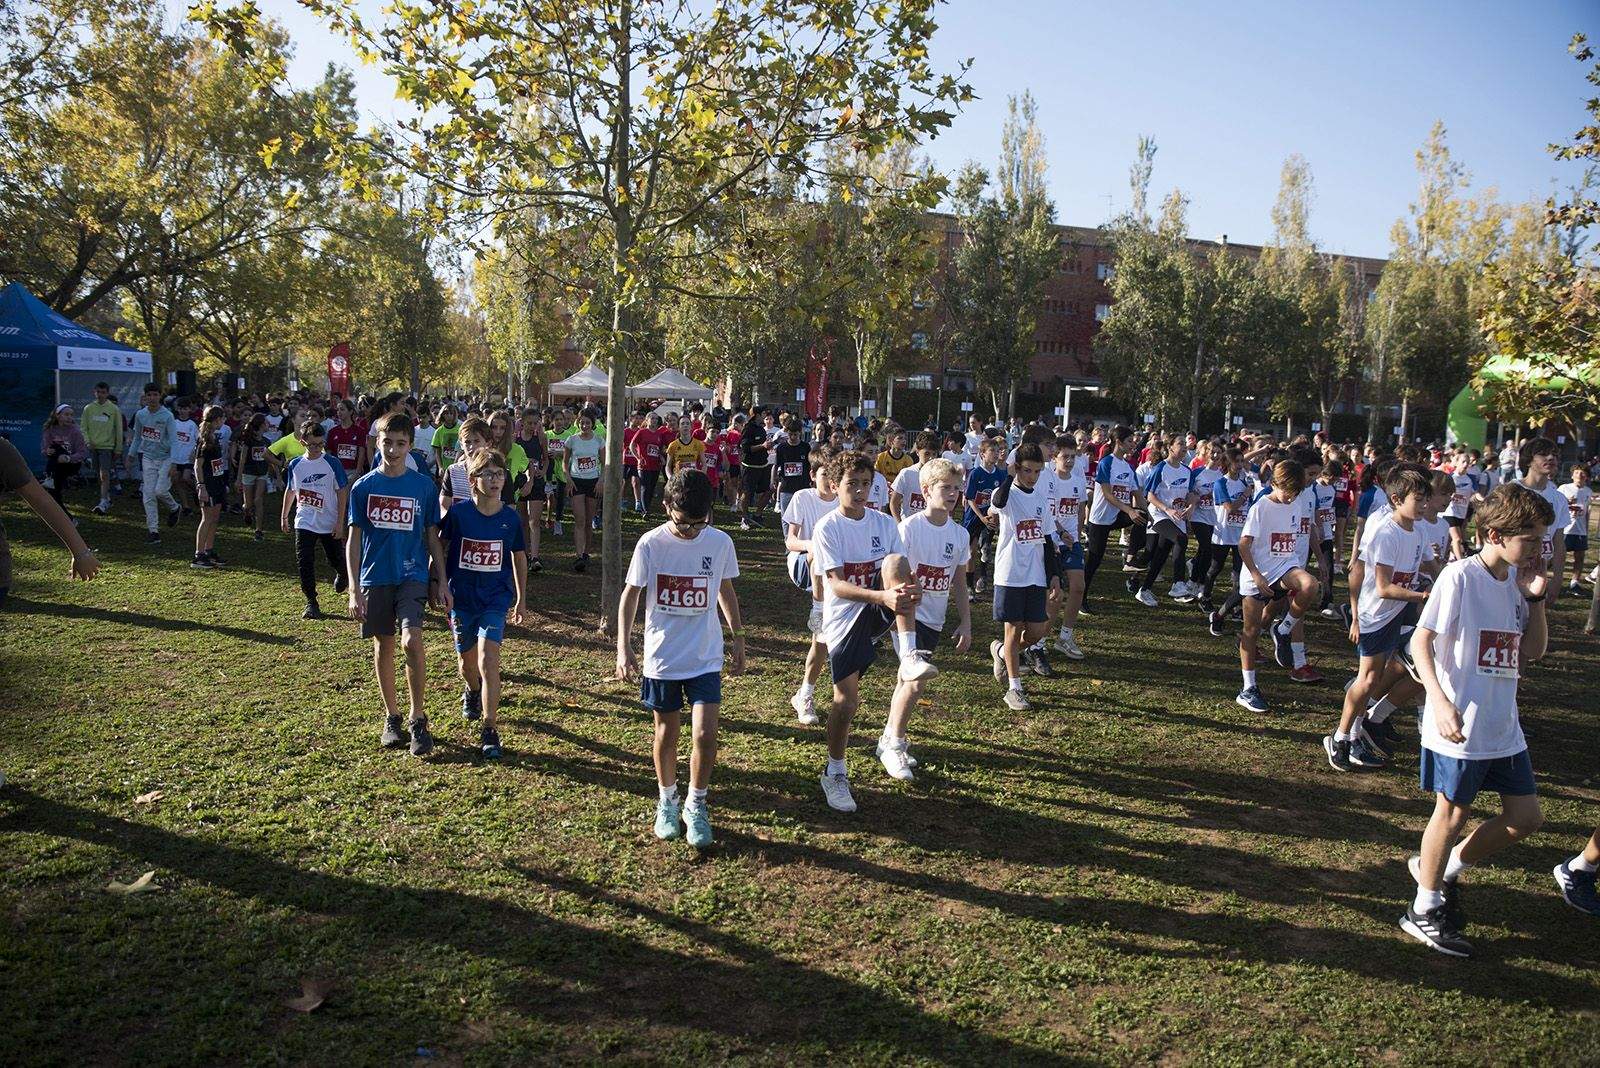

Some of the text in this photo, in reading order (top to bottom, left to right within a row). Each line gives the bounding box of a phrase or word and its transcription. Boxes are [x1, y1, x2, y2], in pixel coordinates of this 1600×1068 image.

[300, 495, 323, 506] 2371
[370, 507, 411, 522] 4680
[463, 550, 500, 564] 4673
[847, 574, 876, 588] 417
[660, 588, 706, 607] 4160
[1482, 647, 1519, 667] 418
